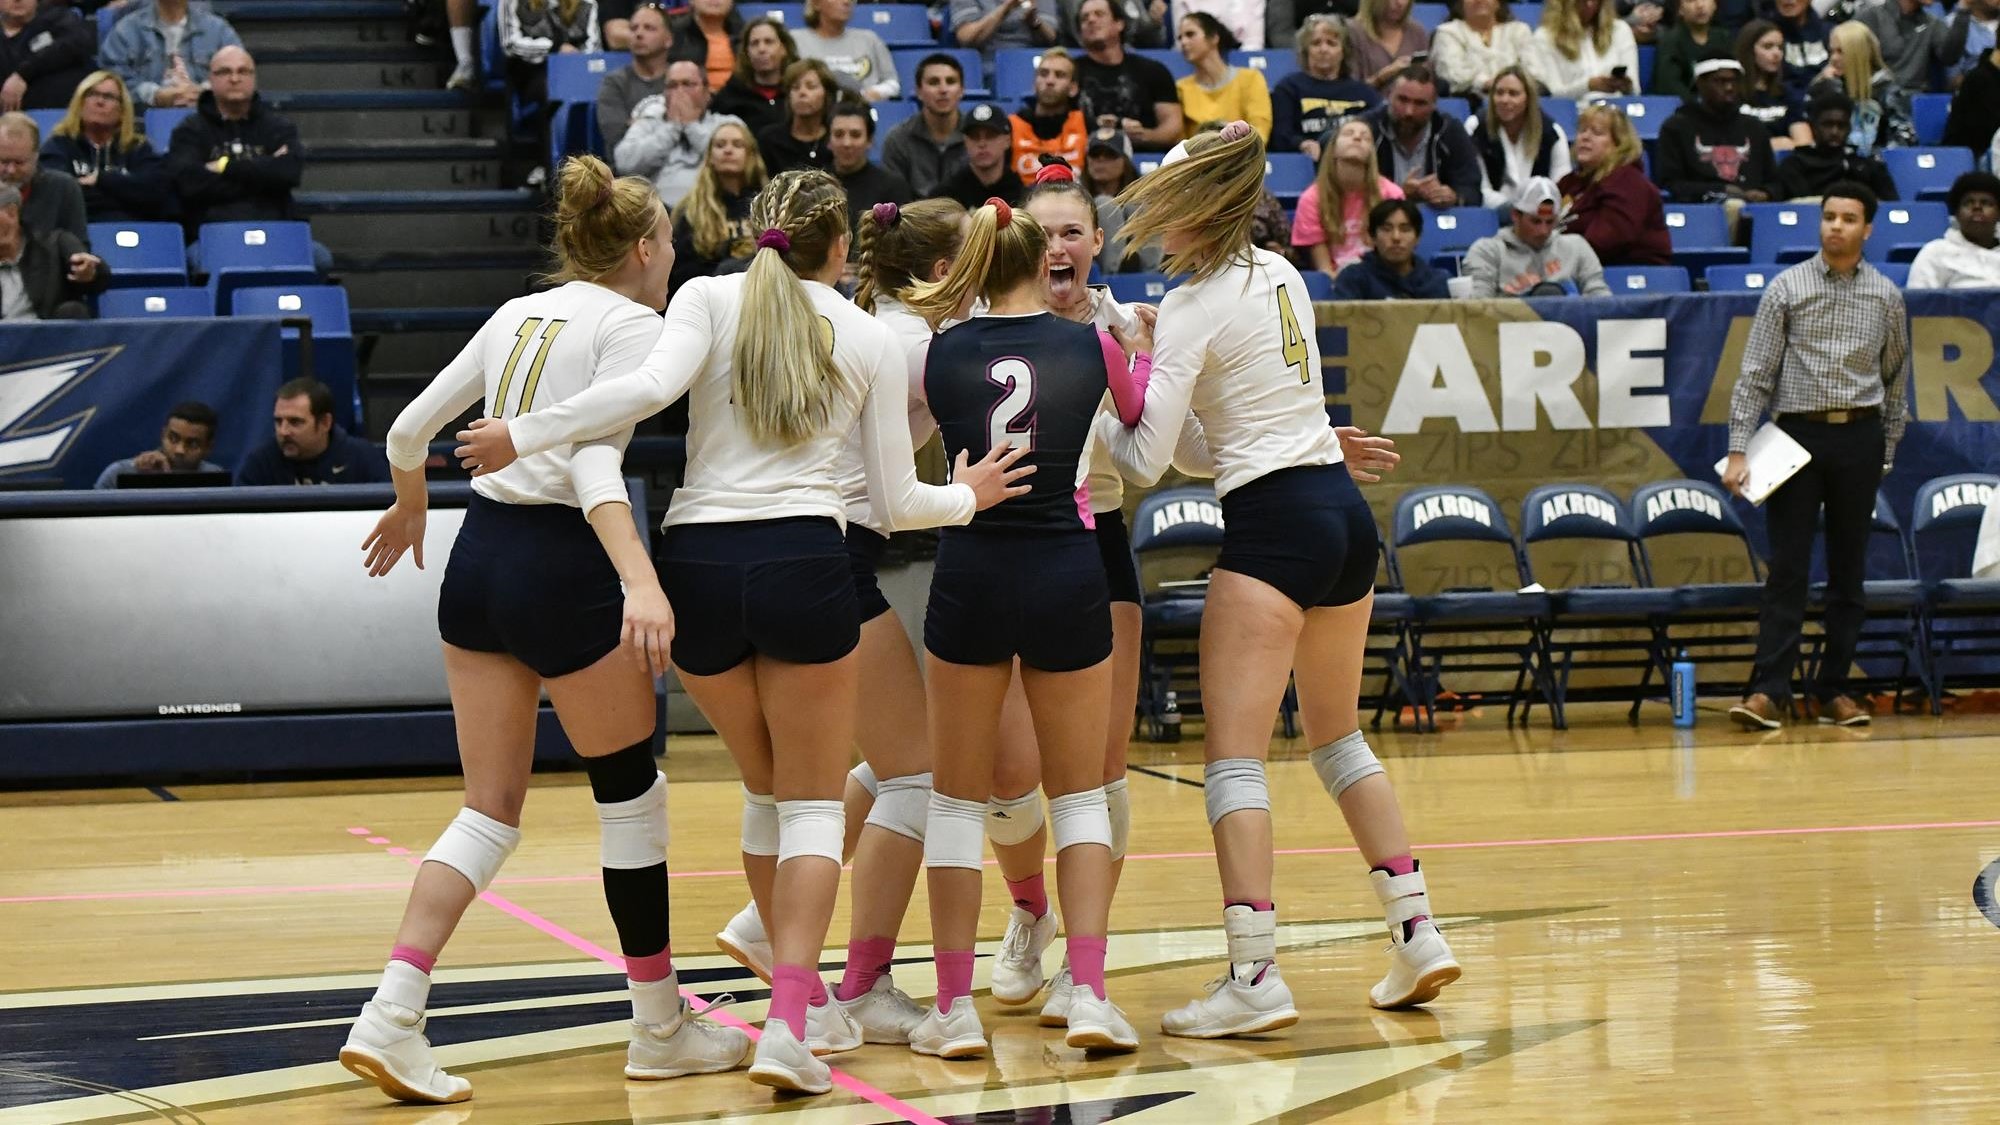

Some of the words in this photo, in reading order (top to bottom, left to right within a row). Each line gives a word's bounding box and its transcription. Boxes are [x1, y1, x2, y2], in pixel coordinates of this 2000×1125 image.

[1277, 283, 1310, 385] 4
[492, 317, 568, 418] 11
[1381, 318, 1671, 434] ARE
[985, 355, 1038, 453] 2
[1413, 494, 1491, 530] AKRON
[1542, 491, 1617, 527] AKRON
[1646, 487, 1722, 523] AKRON
[1932, 483, 1994, 519] AKRO
[158, 703, 242, 715] DAKTRONICS
